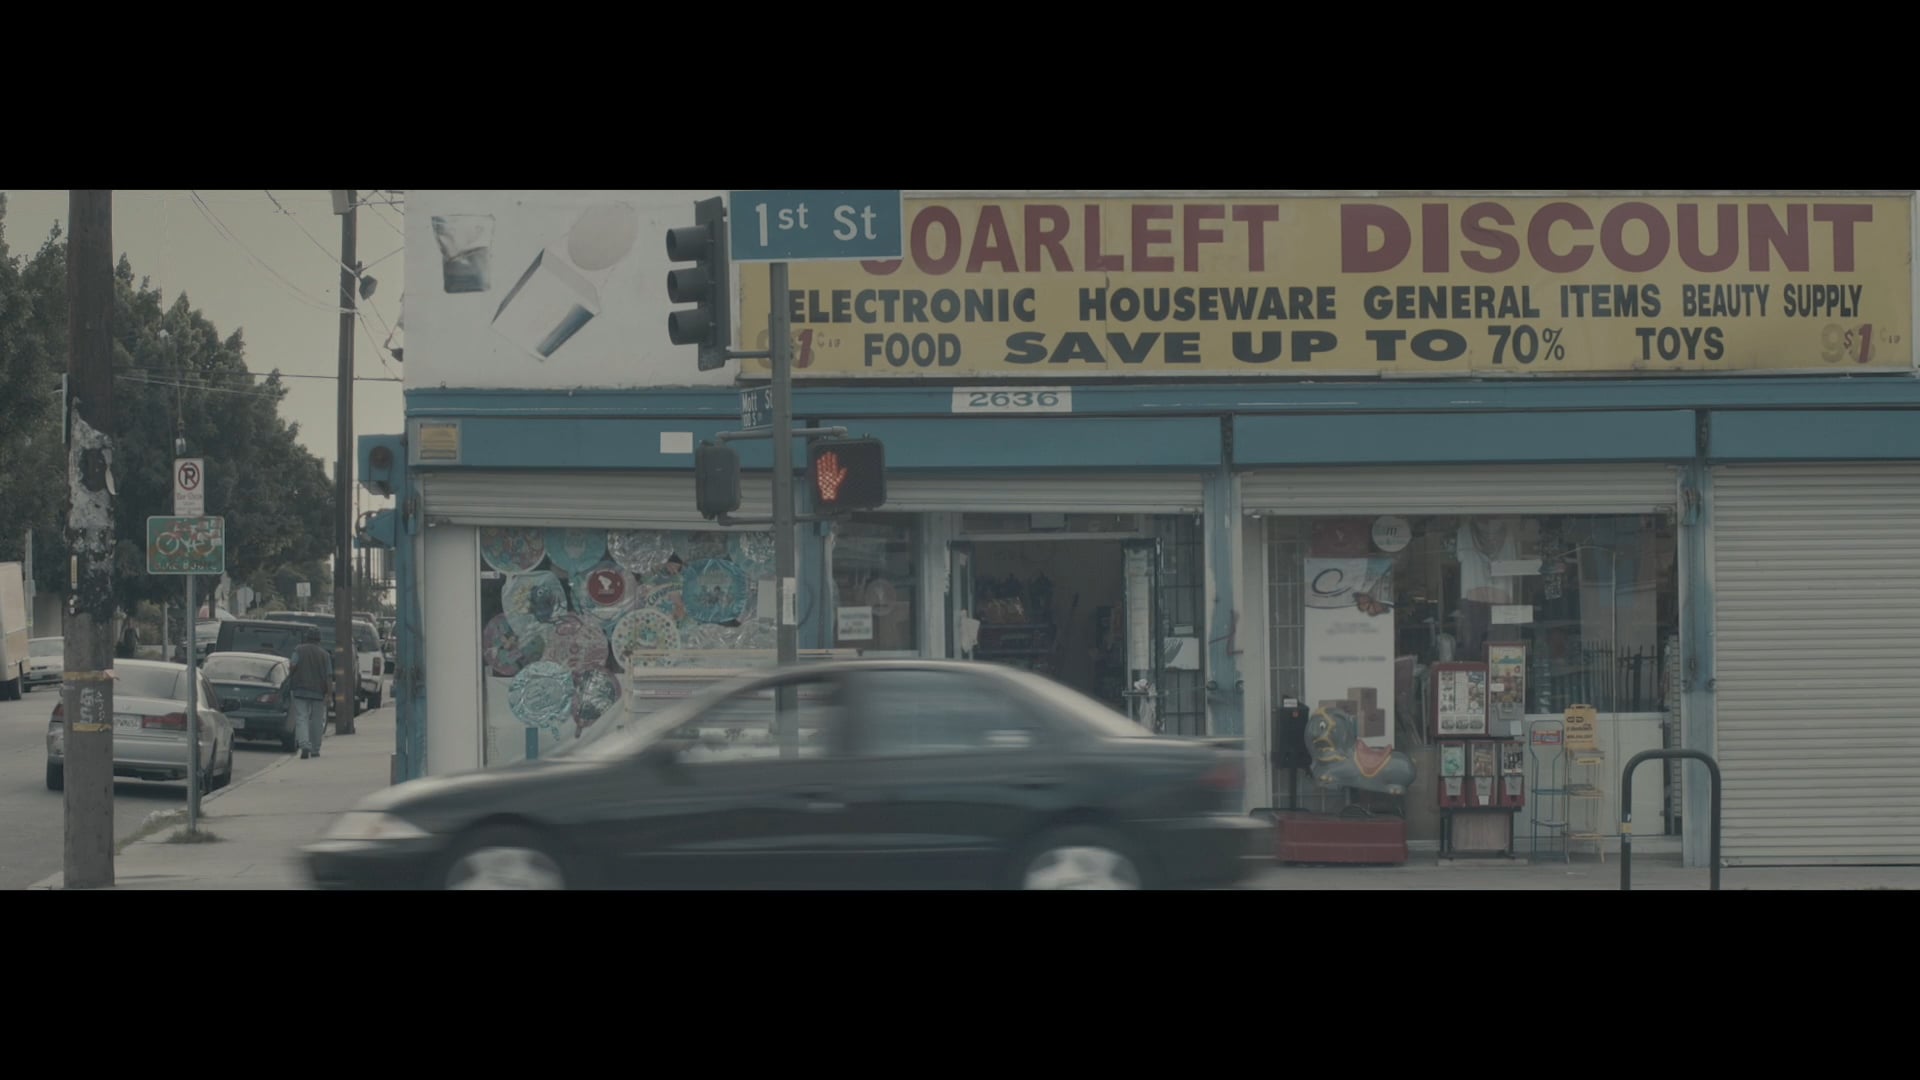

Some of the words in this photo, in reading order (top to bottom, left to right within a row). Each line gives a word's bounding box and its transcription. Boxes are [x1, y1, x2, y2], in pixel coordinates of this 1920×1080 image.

[756, 203, 808, 247] 1st
[833, 204, 877, 241] St
[859, 204, 1280, 275] OARLEFT
[1341, 202, 1873, 273] DISCOUNT
[789, 288, 1036, 323] ELECTRONIC
[1079, 286, 1336, 322] HOUSEWARE
[1363, 285, 1540, 319] GENERAL
[1560, 284, 1661, 318] ITEMS
[1682, 284, 1769, 317] BEAUTY
[1783, 283, 1863, 317] SUPPLY
[864, 333, 961, 367] FOOD
[1004, 331, 1201, 364] SAVE
[1232, 331, 1338, 364] UP
[1365, 329, 1467, 362] TO
[1487, 325, 1565, 364] 70%
[1635, 327, 1724, 361] TOYS
[742, 391, 758, 412] Mott
[968, 391, 1059, 408] 2636
